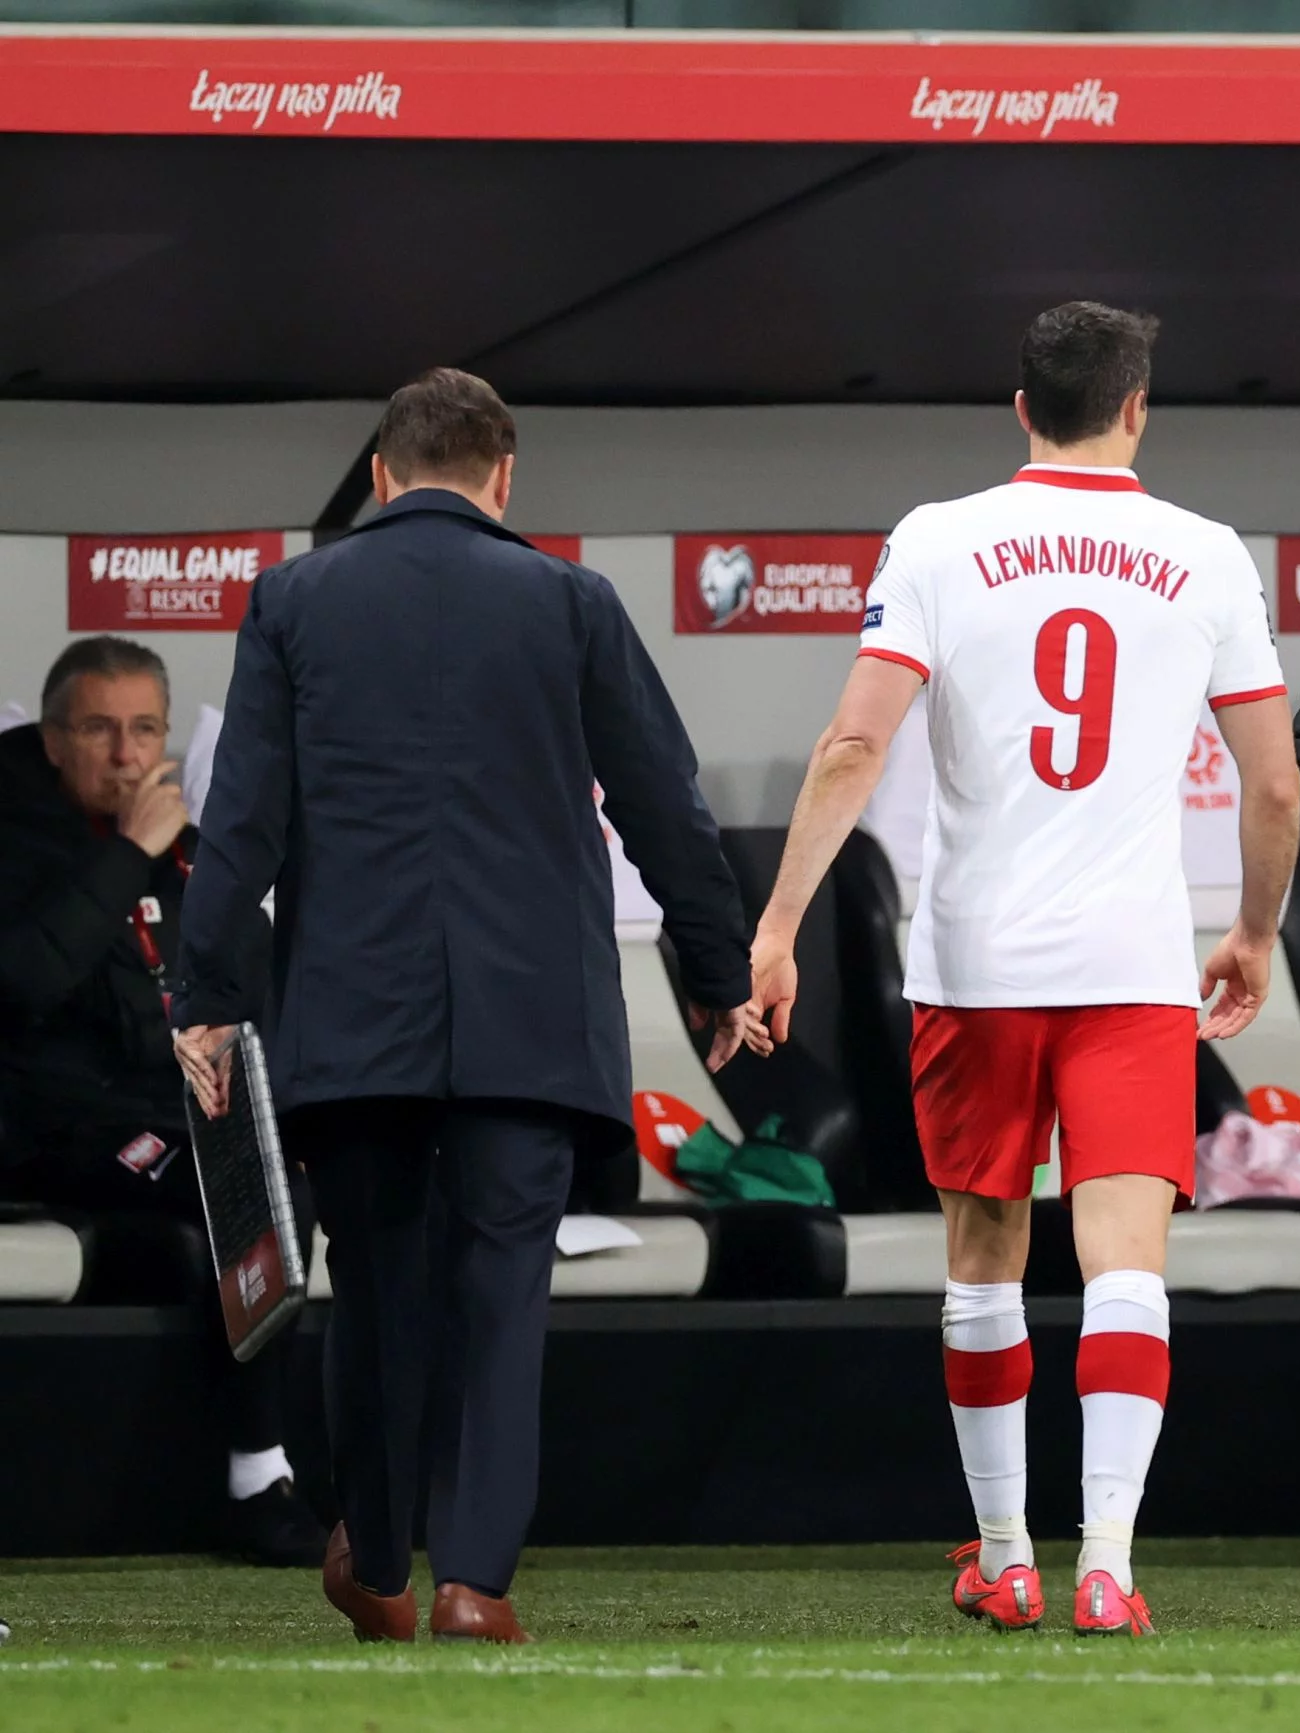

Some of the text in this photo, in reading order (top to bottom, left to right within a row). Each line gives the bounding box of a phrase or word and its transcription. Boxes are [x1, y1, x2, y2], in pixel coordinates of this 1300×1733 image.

[189, 69, 401, 131] Łączy nas piłka
[910, 76, 1119, 138] Łączy nas piłka
[764, 563, 853, 587] EUROPEAN
[973, 535, 1190, 602] LEWANDOWSKI
[150, 590, 222, 612] RESPECT
[754, 586, 864, 617] QUALIFIERS
[1030, 607, 1117, 791] 9
